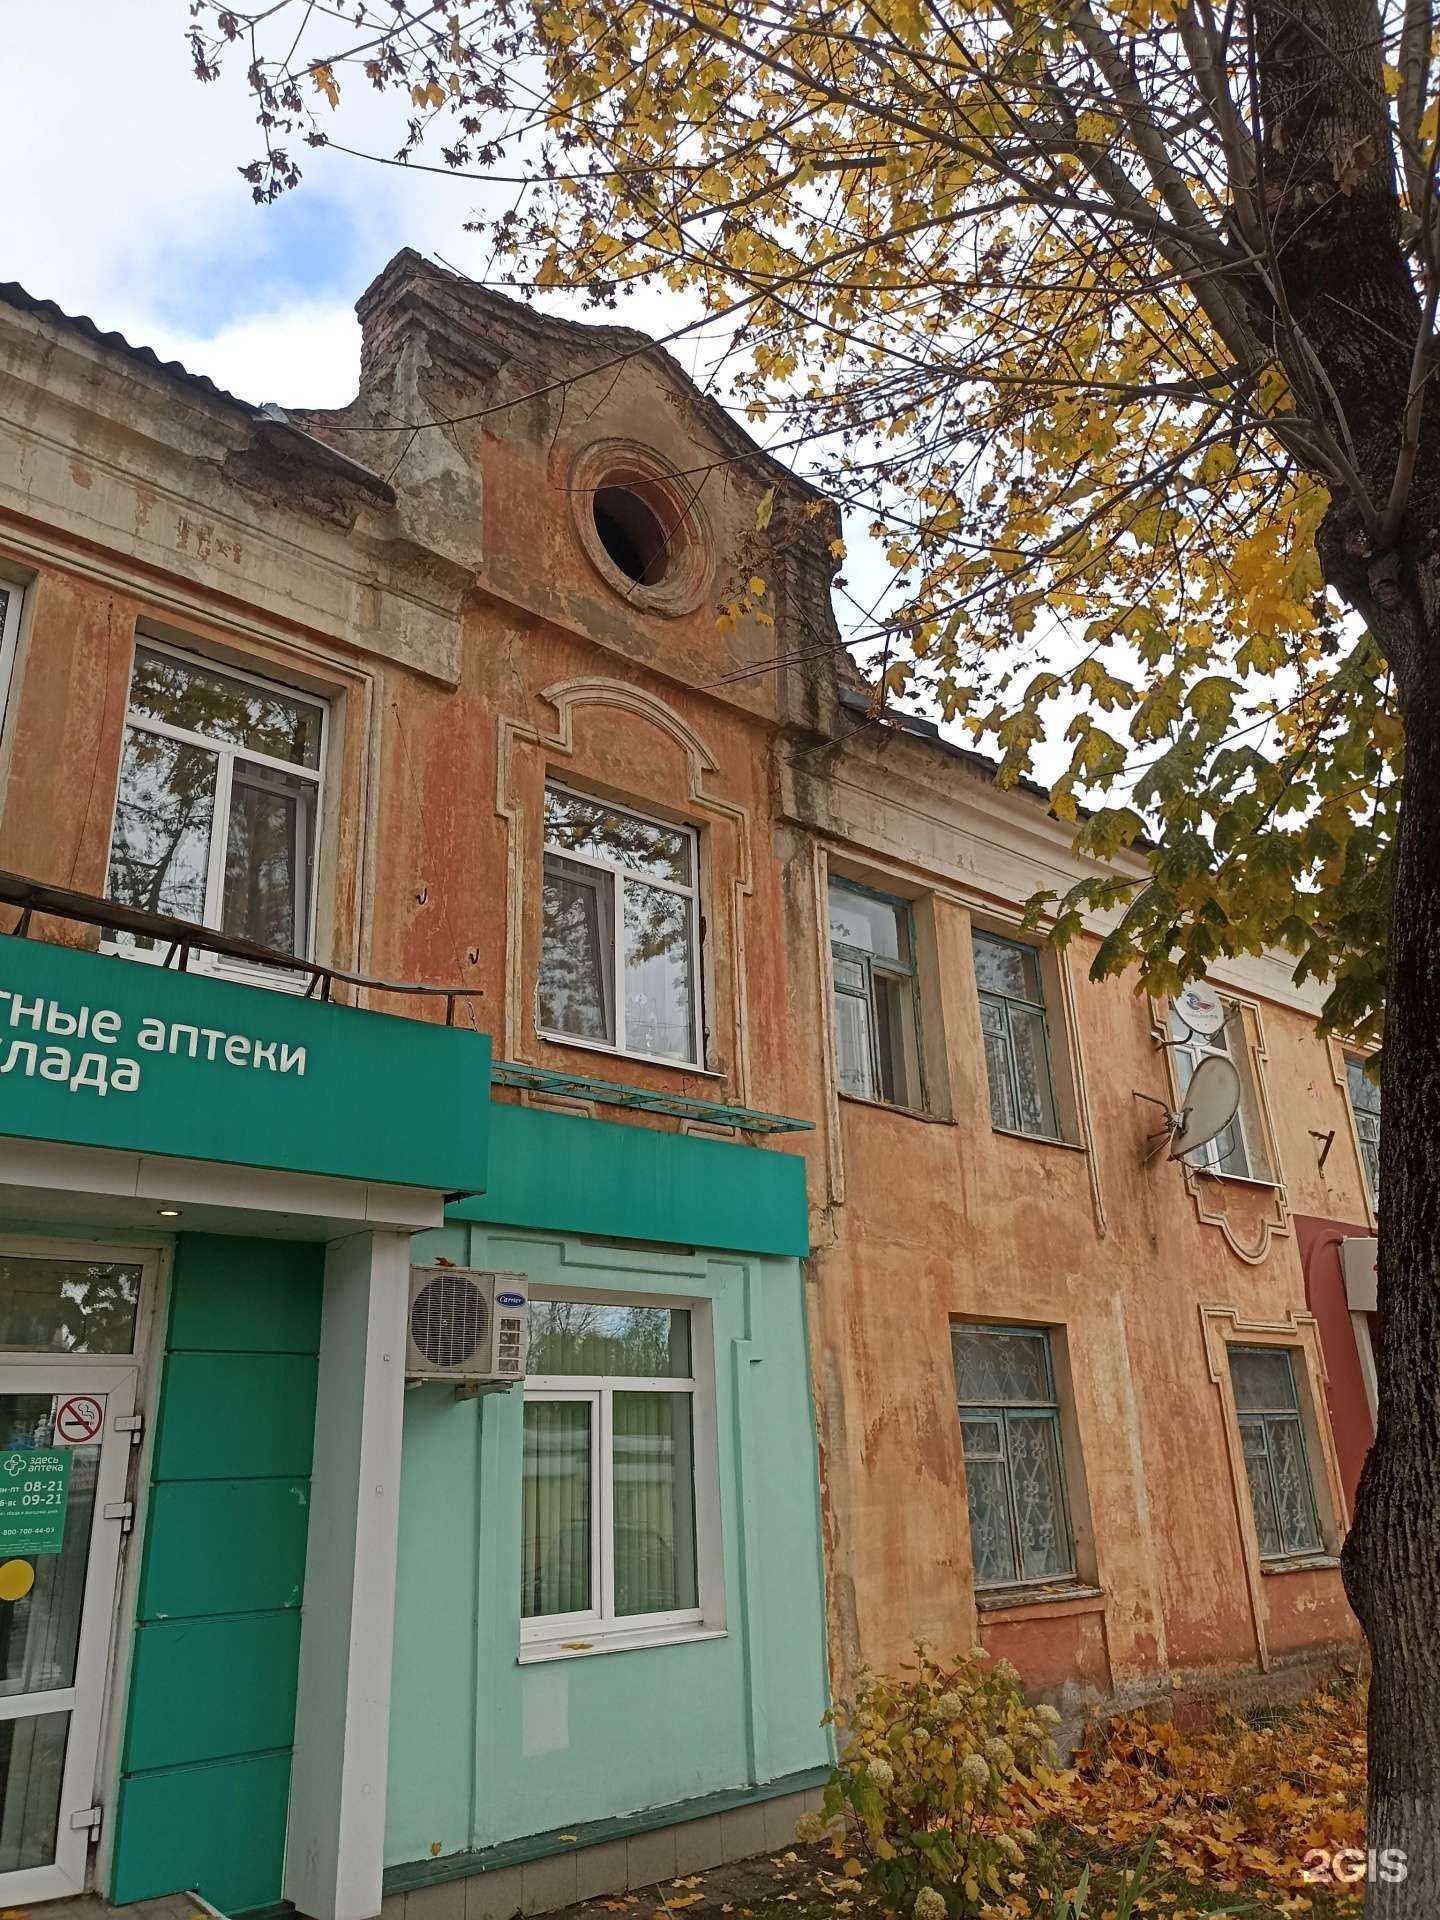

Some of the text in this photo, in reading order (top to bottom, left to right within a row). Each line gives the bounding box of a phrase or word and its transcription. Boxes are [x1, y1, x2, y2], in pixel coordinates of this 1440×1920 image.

[137, 1017, 307, 1076] аптеки
[0, 1038, 140, 1097] лада
[500, 1295, 521, 1304] Carrier
[30, 1456, 59, 1465] здесь
[28, 1464, 64, 1472] аптека
[24, 1480, 63, 1492] 08-21
[22, 1493, 62, 1506] 09-21
